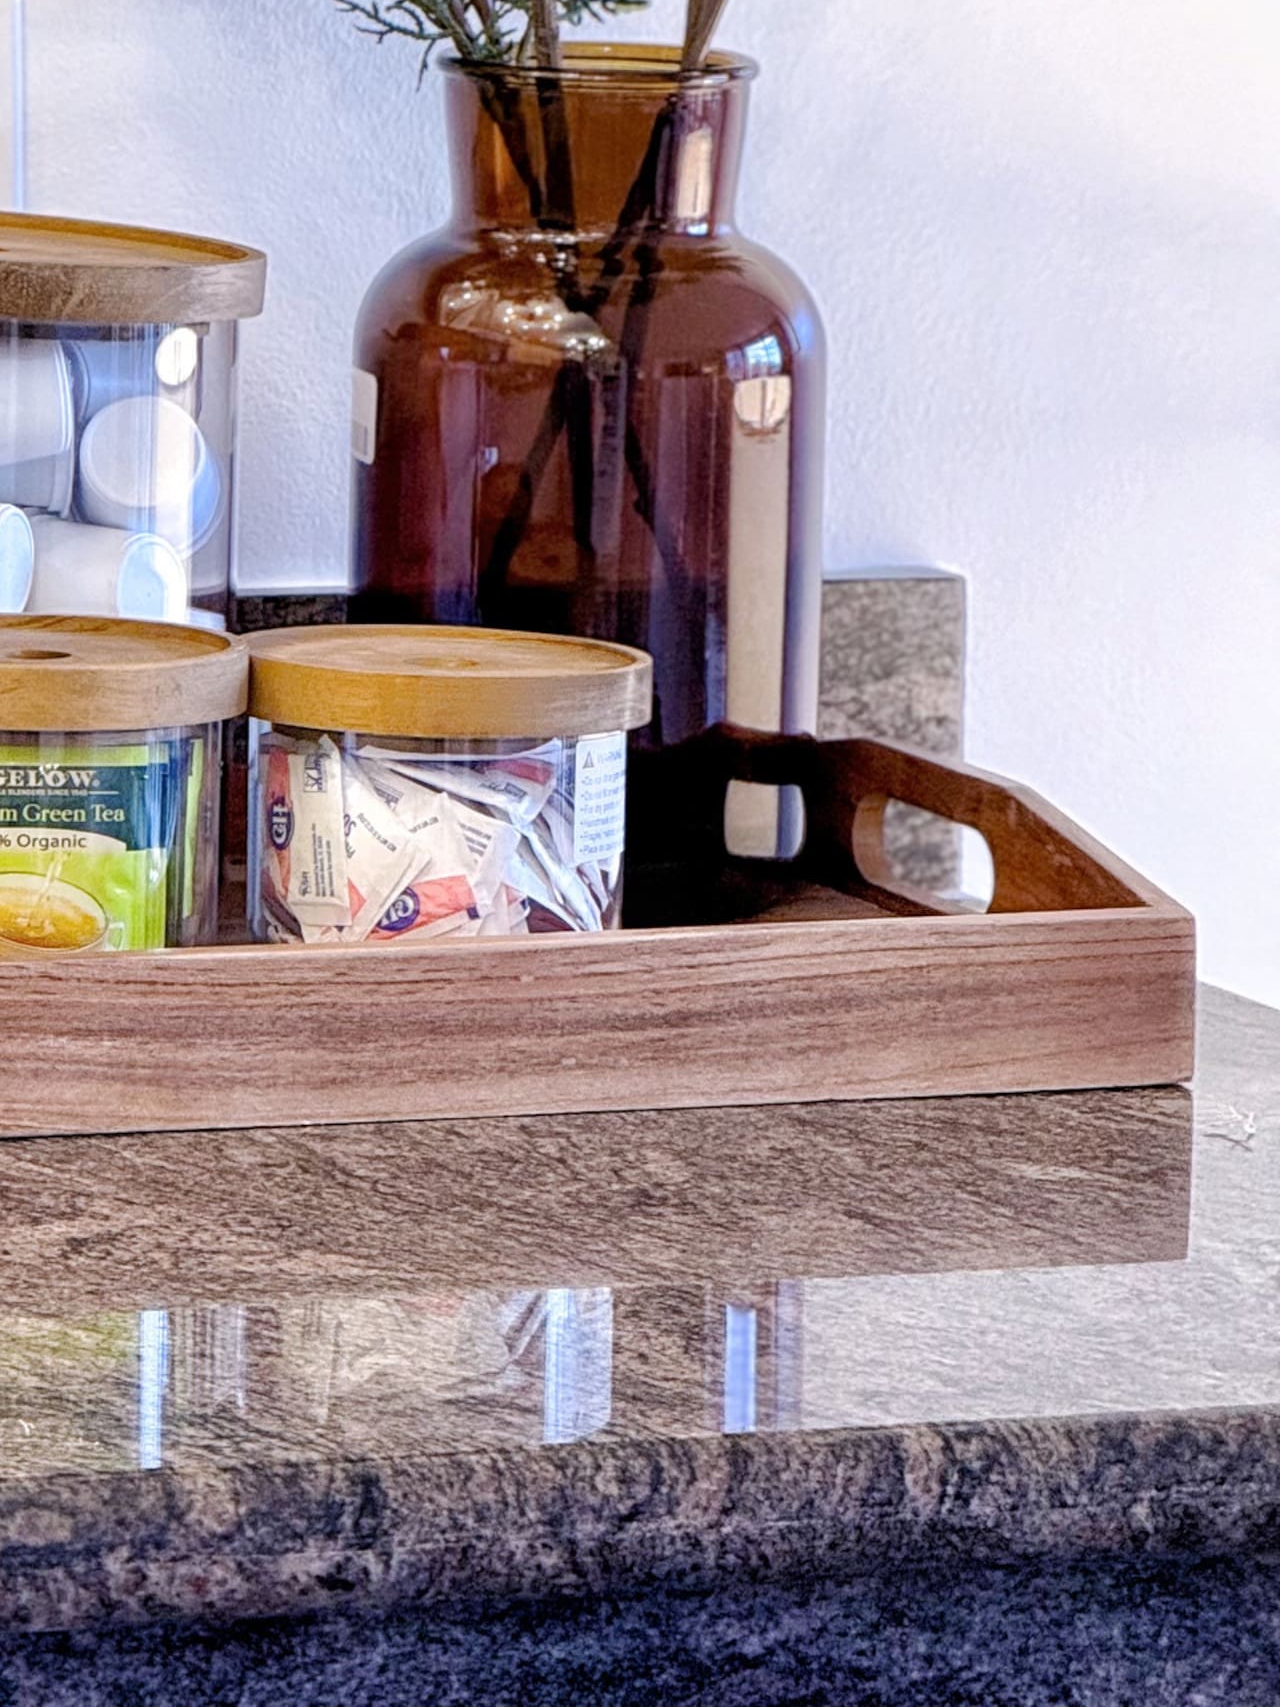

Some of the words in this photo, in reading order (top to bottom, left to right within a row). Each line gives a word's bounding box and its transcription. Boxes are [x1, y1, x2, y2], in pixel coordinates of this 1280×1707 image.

[23, 804, 86, 822] Green
[91, 804, 125, 822] Tea
[17, 833, 88, 851] Organic
